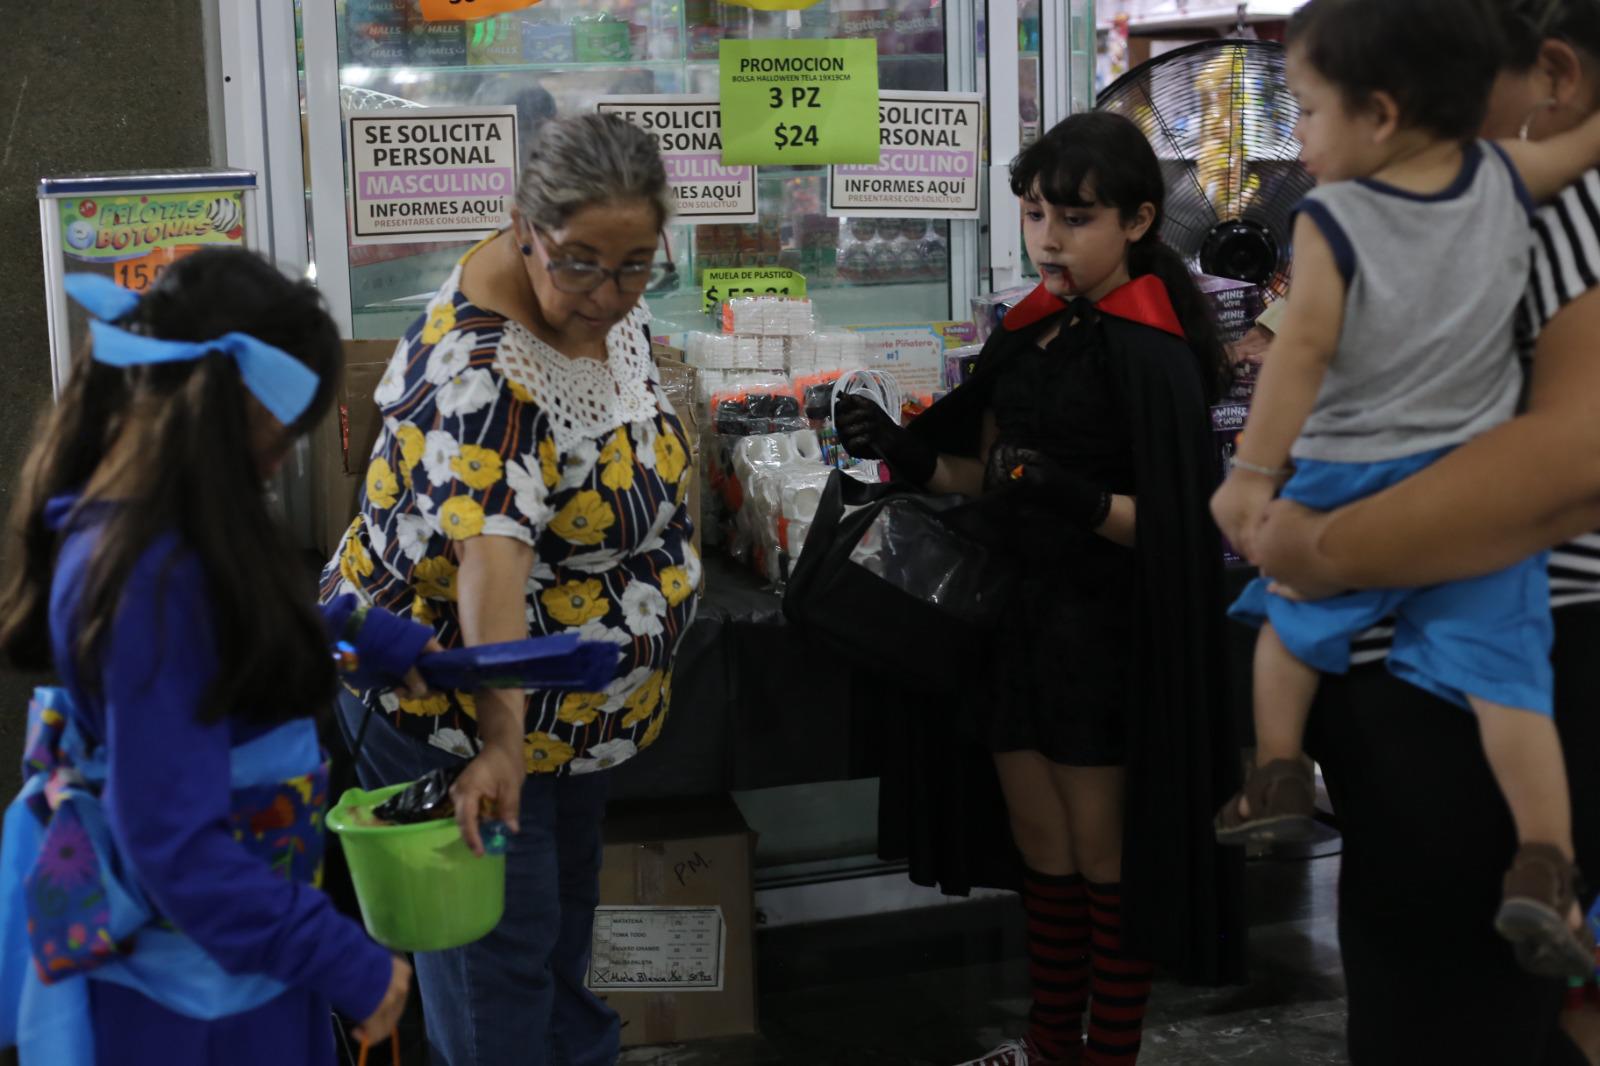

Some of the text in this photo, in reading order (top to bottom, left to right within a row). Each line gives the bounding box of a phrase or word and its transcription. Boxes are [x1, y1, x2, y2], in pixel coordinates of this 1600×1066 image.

[370, 25, 400, 36] HALLS
[427, 23, 460, 34] HALLS
[740, 57, 844, 73] PROMOCION
[769, 87, 821, 109] 3 PZ
[642, 110, 721, 129] SOLICIT
[365, 123, 502, 144] SE SOLICITA
[774, 122, 819, 150] $24
[880, 128, 961, 147] RSONAL
[373, 146, 495, 167] PERSONAL
[366, 172, 505, 196] MASCULINO
[701, 181, 741, 200] AQUÍ
[845, 177, 965, 196] INFORMES AQUÍ
[370, 195, 504, 218] INFORMES AQUÍ
[696, 200, 738, 209] SOLICITUD
[848, 194, 961, 204] PRESENTARSE CON SOLICITUD
[99, 199, 205, 226] PELOTAS
[374, 215, 501, 228] PRESENTARSE CON SOLICITUD
[95, 221, 211, 250] BOTONAS
[710, 270, 793, 280] MUELA DE PLASTICO
[1215, 406, 1248, 417] WINIS
